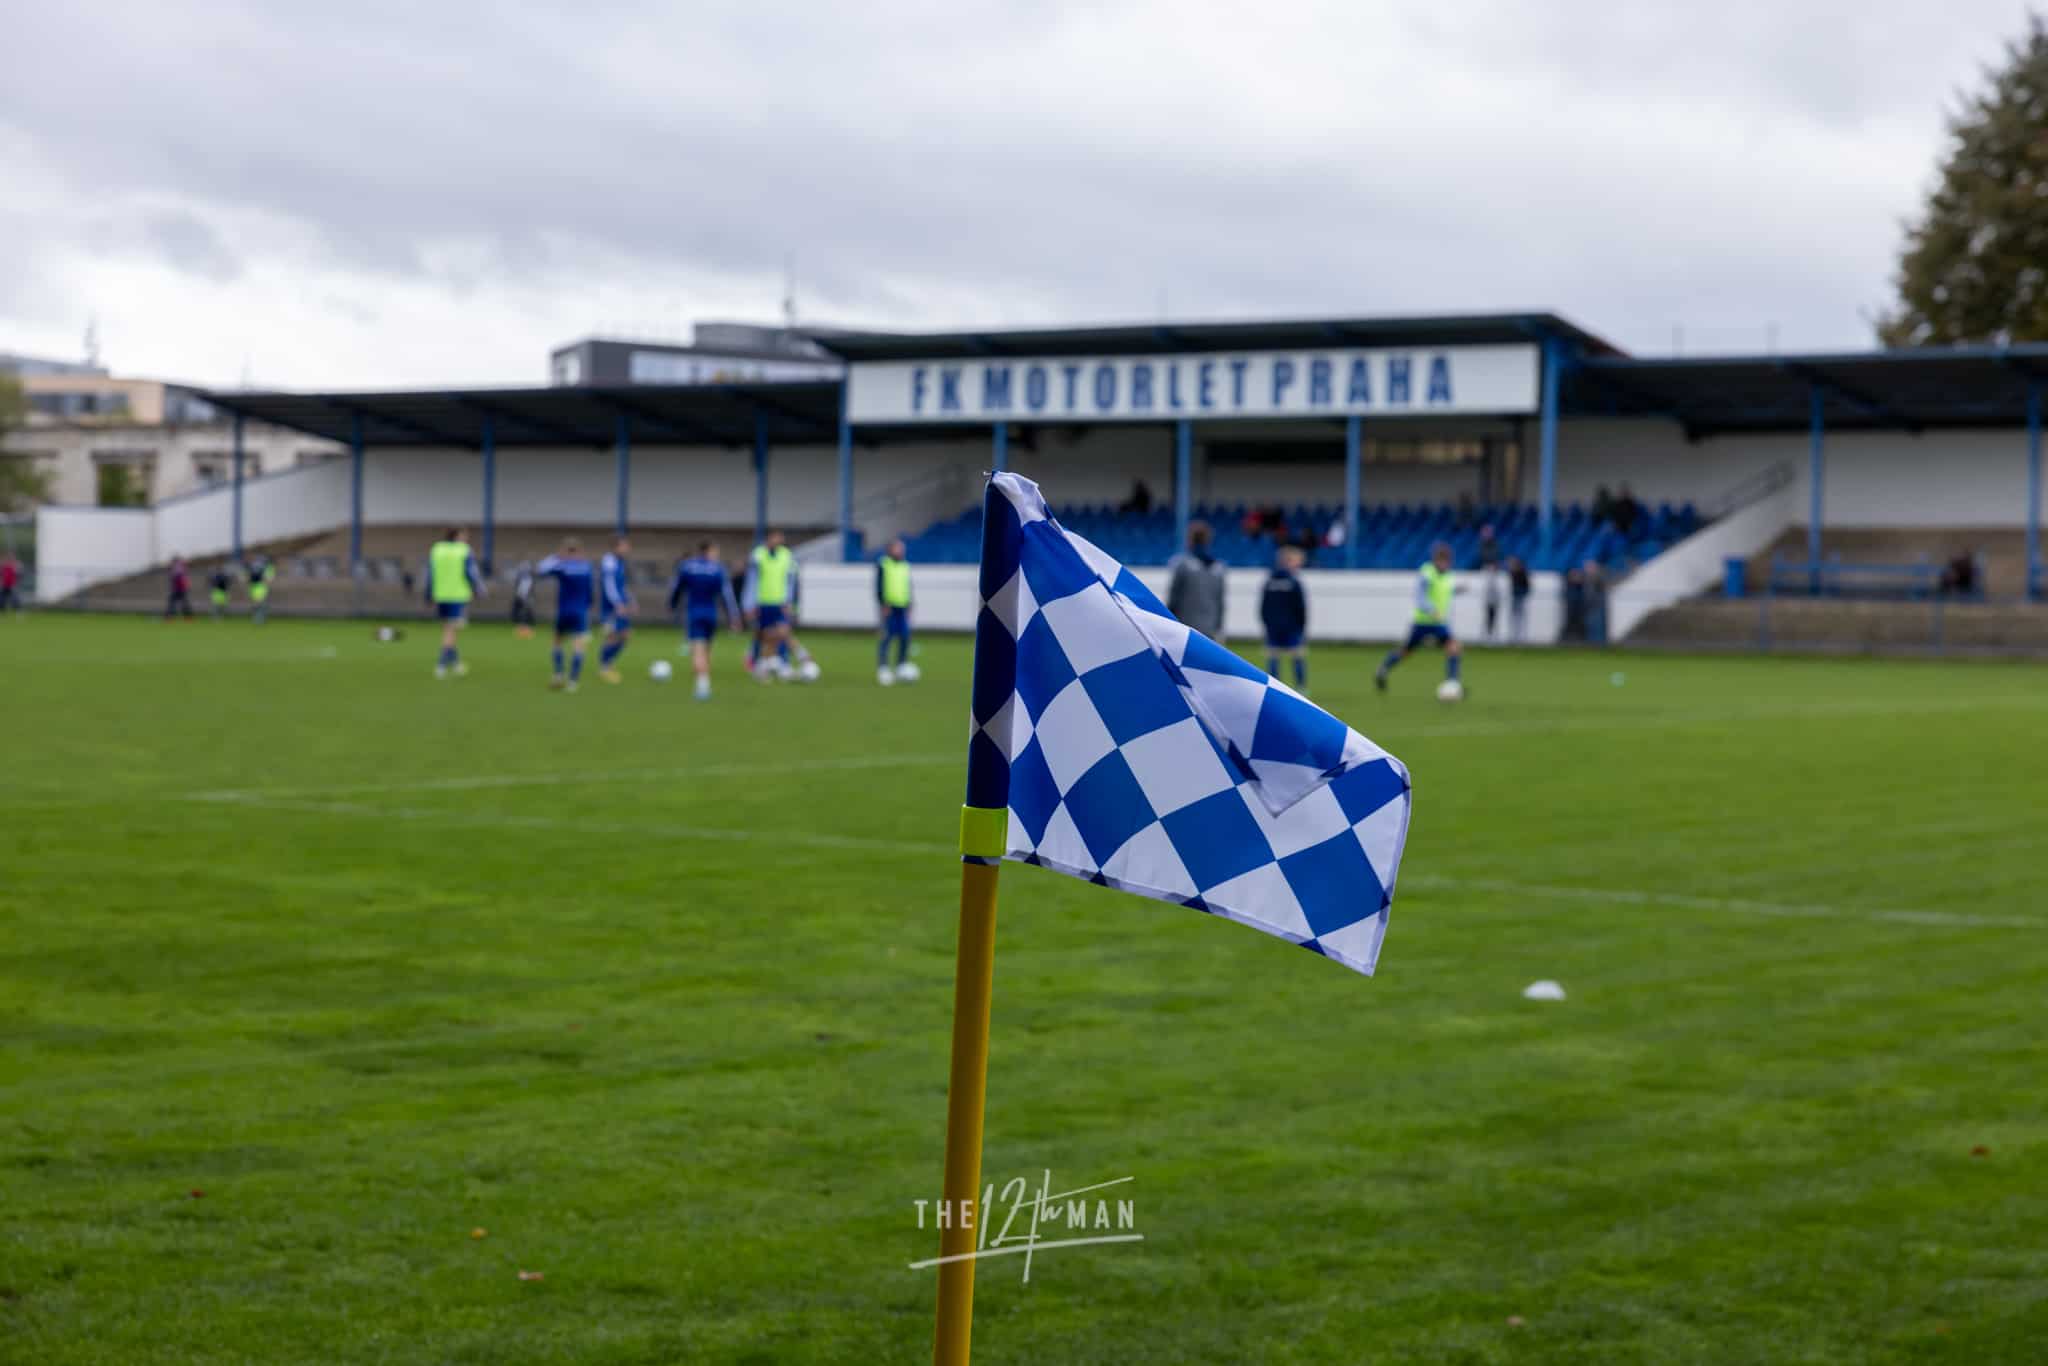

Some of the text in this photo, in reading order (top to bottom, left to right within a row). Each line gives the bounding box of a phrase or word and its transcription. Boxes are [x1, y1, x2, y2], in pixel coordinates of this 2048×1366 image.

[911, 354, 1454, 413] FK MOTORLET PRAHA
